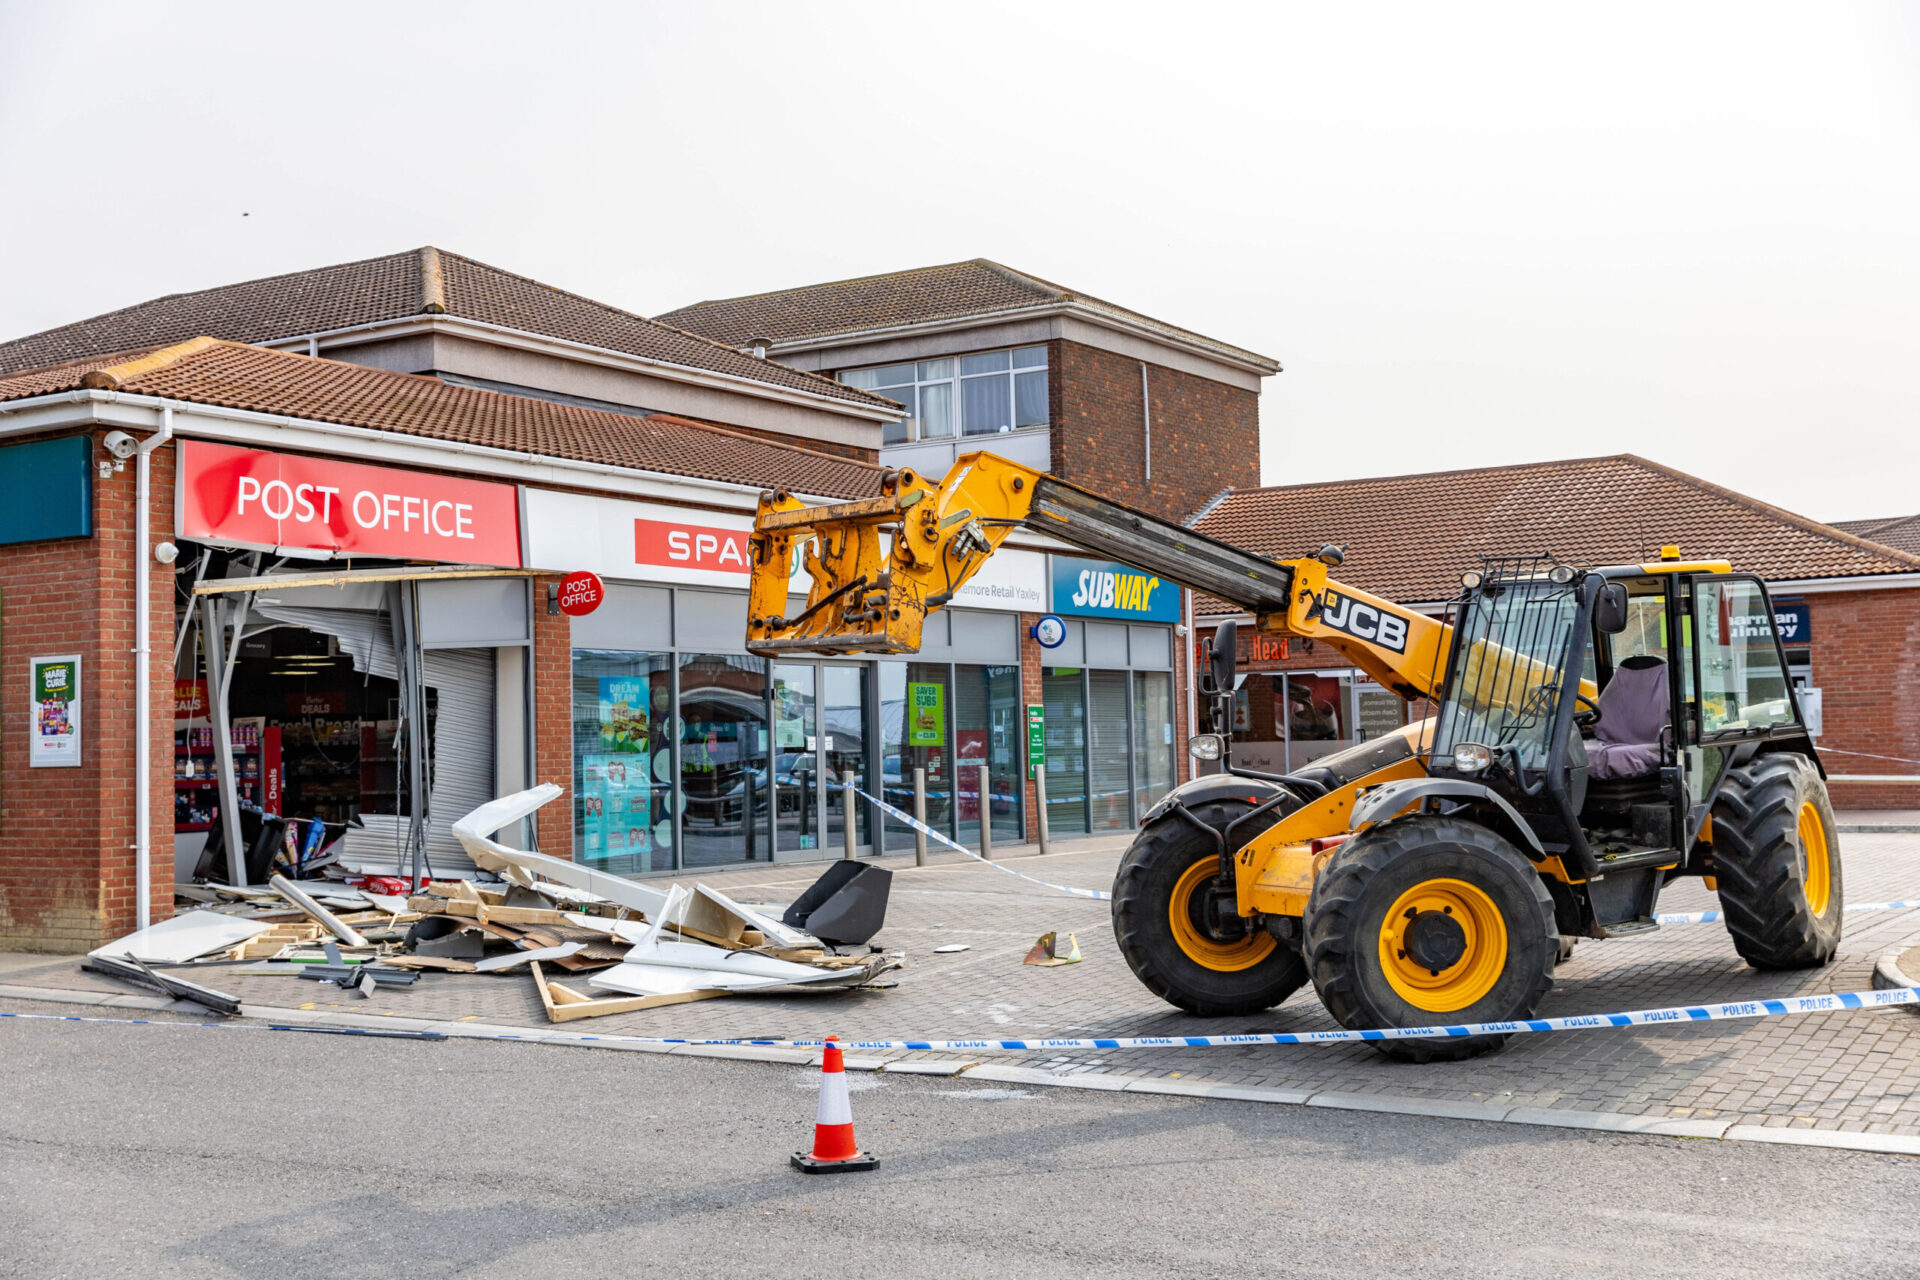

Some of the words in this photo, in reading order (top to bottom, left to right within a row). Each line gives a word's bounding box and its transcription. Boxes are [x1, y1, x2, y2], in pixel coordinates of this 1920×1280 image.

[237, 476, 339, 524] POST
[352, 490, 475, 539] OFFICE
[668, 530, 751, 567] SPA
[566, 578, 592, 594] POST
[991, 585, 1015, 598] Retail
[1015, 586, 1040, 603] Yaxley
[1072, 570, 1159, 611] SUBWAY
[561, 589, 597, 607] OFFICE
[1323, 598, 1406, 650] JCB
[1252, 635, 1289, 661] Head
[45, 669, 67, 680] MARIE
[46, 679, 66, 688] CURIE
[174, 686, 201, 698] ALUE
[609, 683, 640, 695] DREAM
[915, 686, 936, 695] SAVER
[174, 698, 201, 711] EALS
[613, 693, 637, 703] TEAM
[915, 695, 937, 707] SUBS
[269, 768, 277, 800] Deals
[1644, 1010, 1679, 1021] POLICE
[1722, 1003, 1756, 1016] POLICE
[1800, 997, 1833, 1010] POLICE
[1876, 992, 1908, 1004] POLICE
